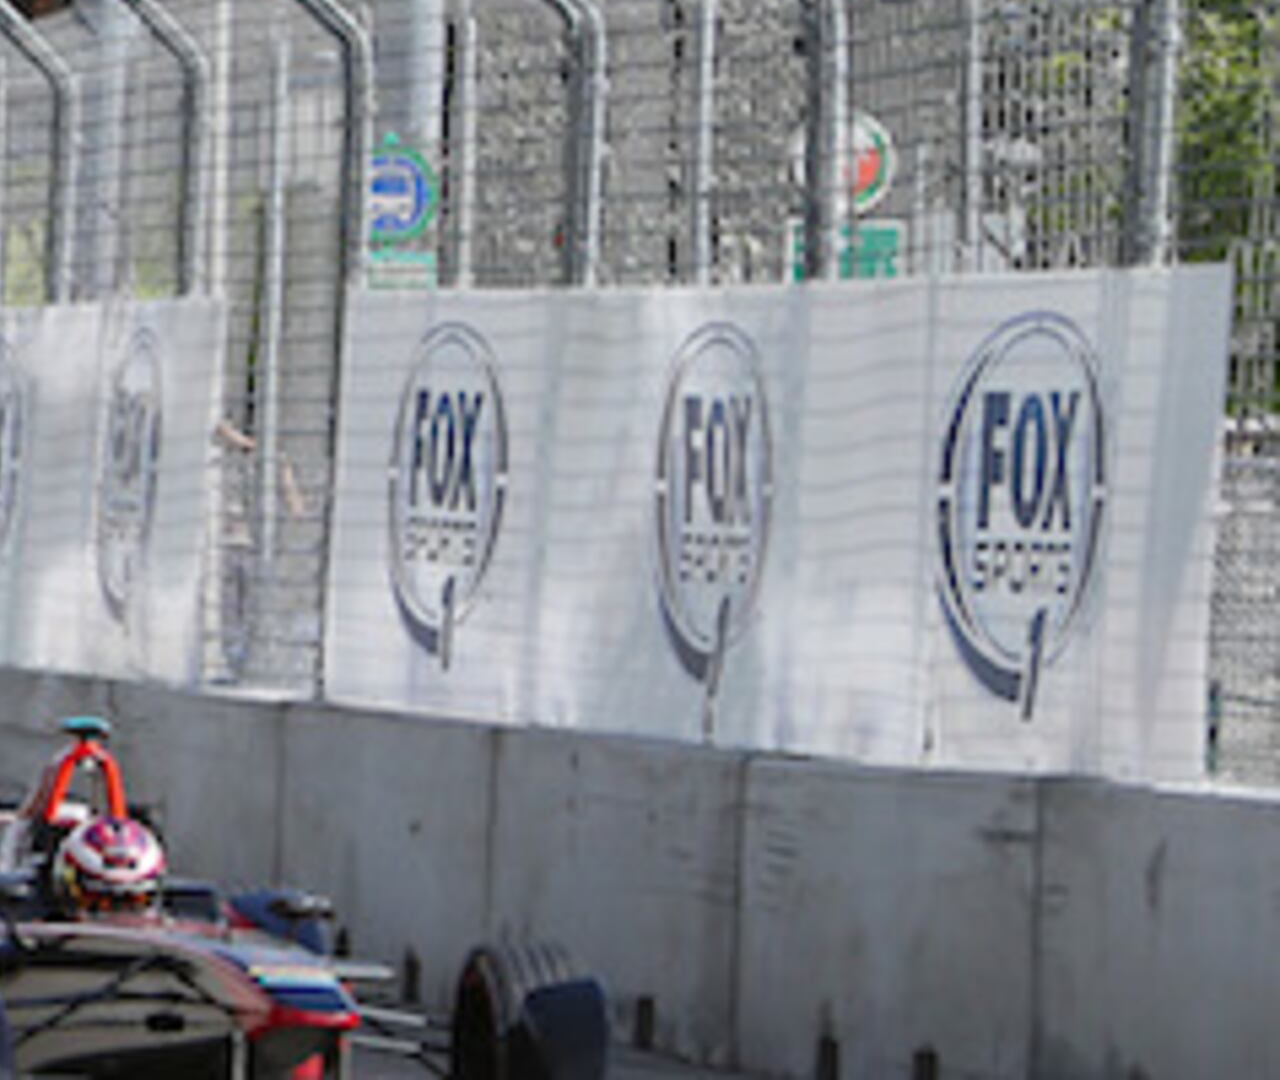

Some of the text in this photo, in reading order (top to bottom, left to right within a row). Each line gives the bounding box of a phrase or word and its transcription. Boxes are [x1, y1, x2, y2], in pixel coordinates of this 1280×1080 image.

[409, 387, 484, 513] FOX
[682, 394, 754, 525] FOX
[977, 390, 1081, 531] FOX
[973, 541, 1072, 595] SPORTS
